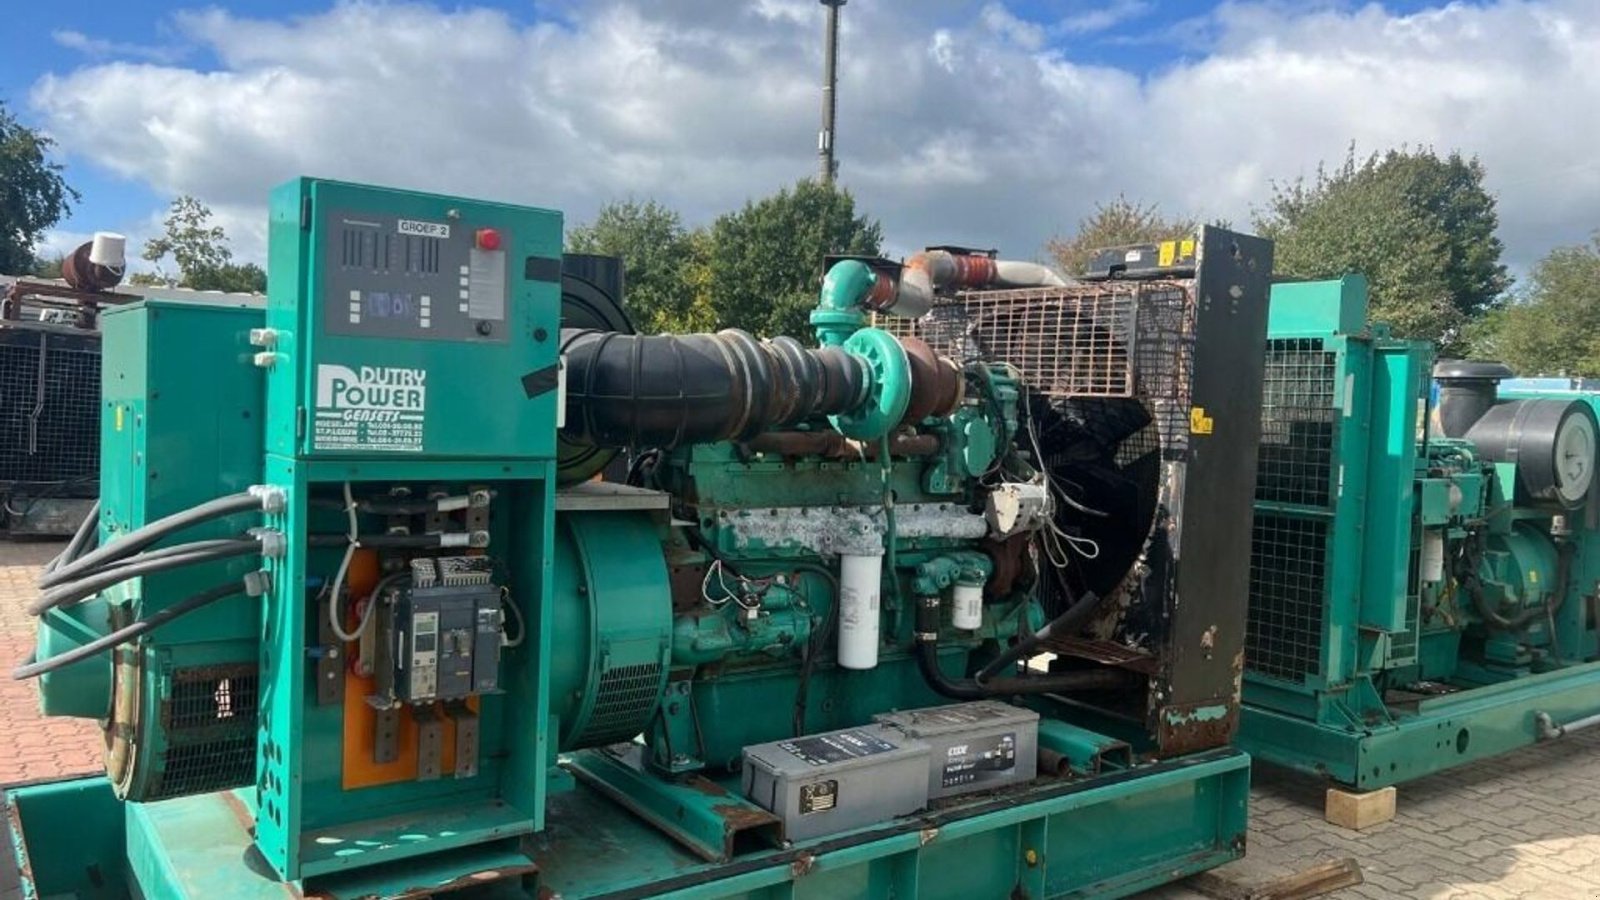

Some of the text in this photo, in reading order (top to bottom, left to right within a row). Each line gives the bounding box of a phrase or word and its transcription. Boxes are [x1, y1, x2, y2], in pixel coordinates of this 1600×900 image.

[440, 226, 447, 236] 2
[361, 366, 426, 386] DUTRY
[343, 409, 400, 422] GENSETS
